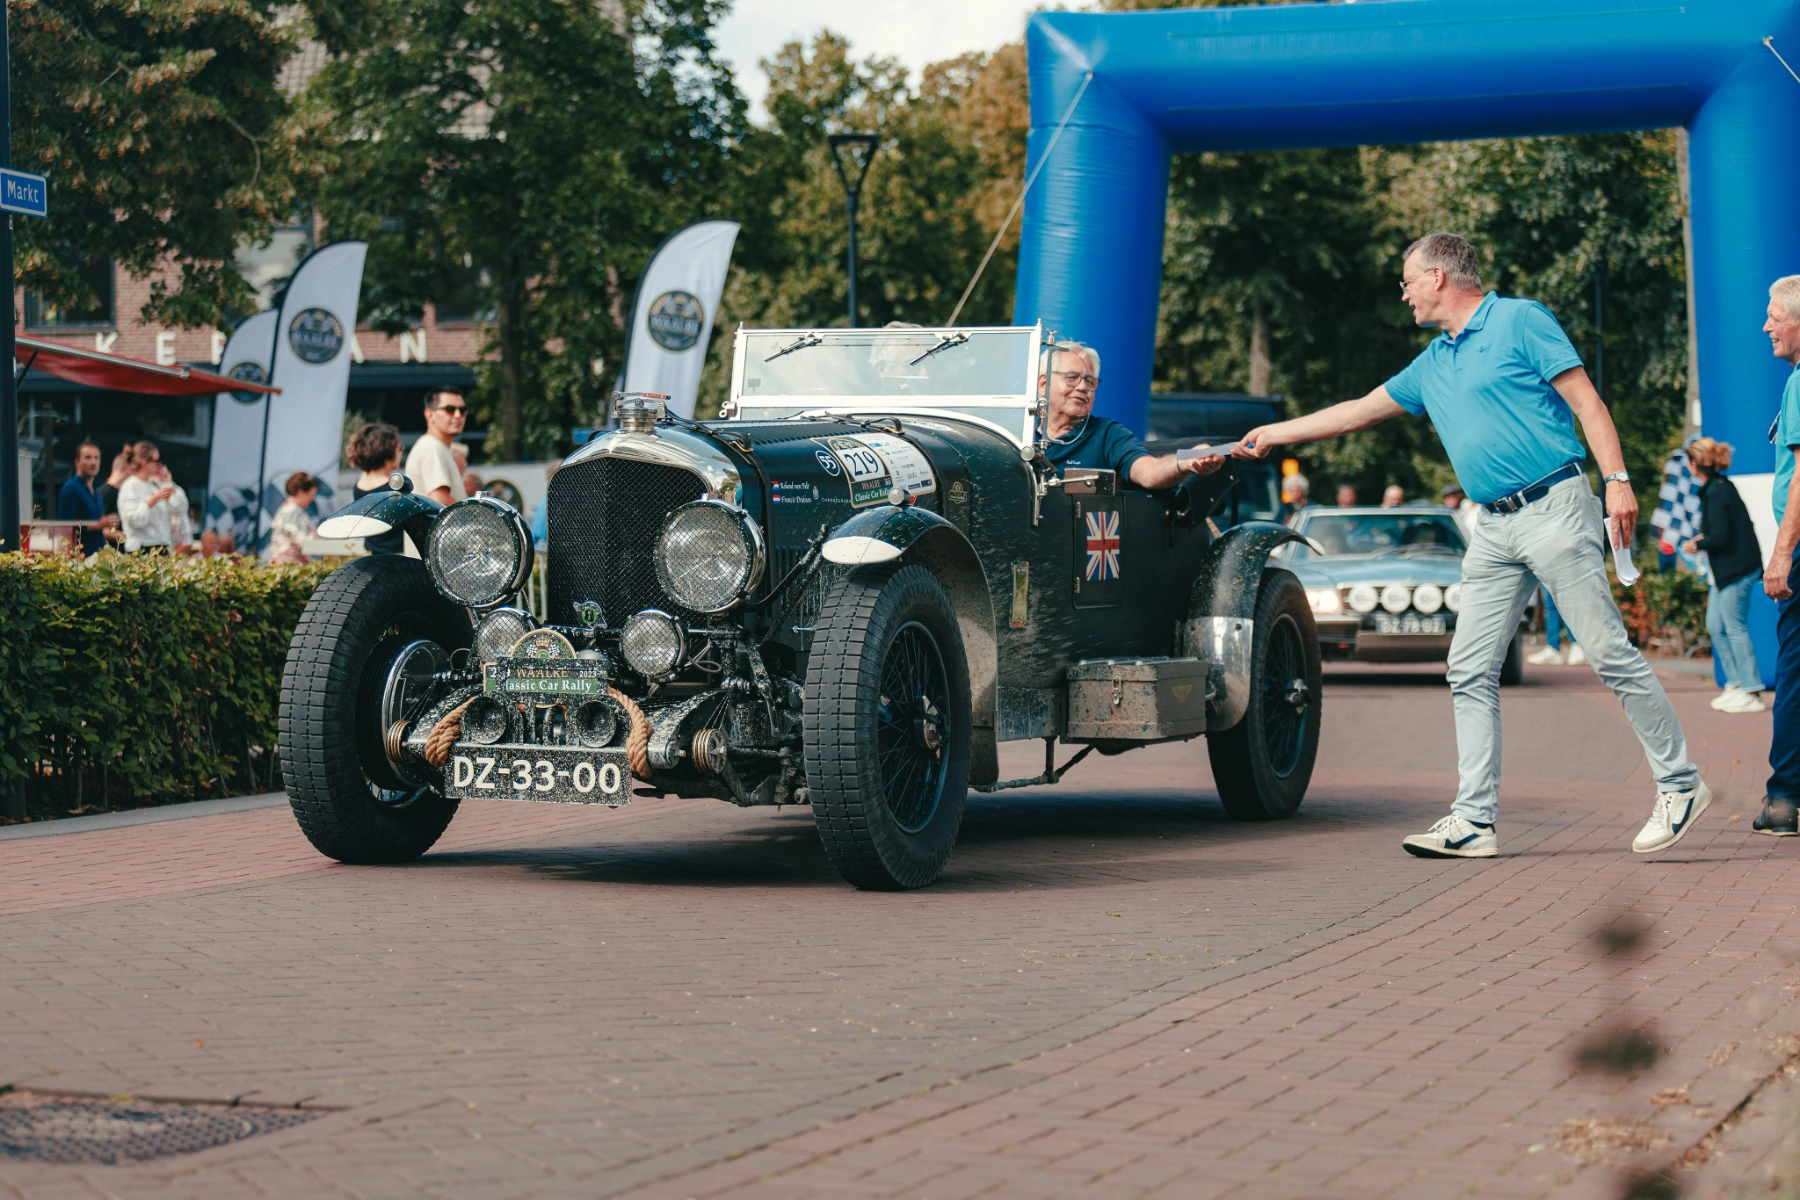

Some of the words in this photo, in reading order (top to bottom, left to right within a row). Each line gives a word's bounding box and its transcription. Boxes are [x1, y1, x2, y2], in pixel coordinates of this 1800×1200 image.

[7, 179, 39, 204] Markt
[819, 455, 837, 470] 55
[844, 451, 879, 477] 219
[854, 491, 871, 502] Classic
[870, 490, 879, 499] Car
[579, 670, 597, 678] 2023
[505, 679, 535, 691] lassic
[539, 680, 559, 691] Car
[562, 679, 592, 693] Rally
[453, 755, 621, 794] DZ-33-00
